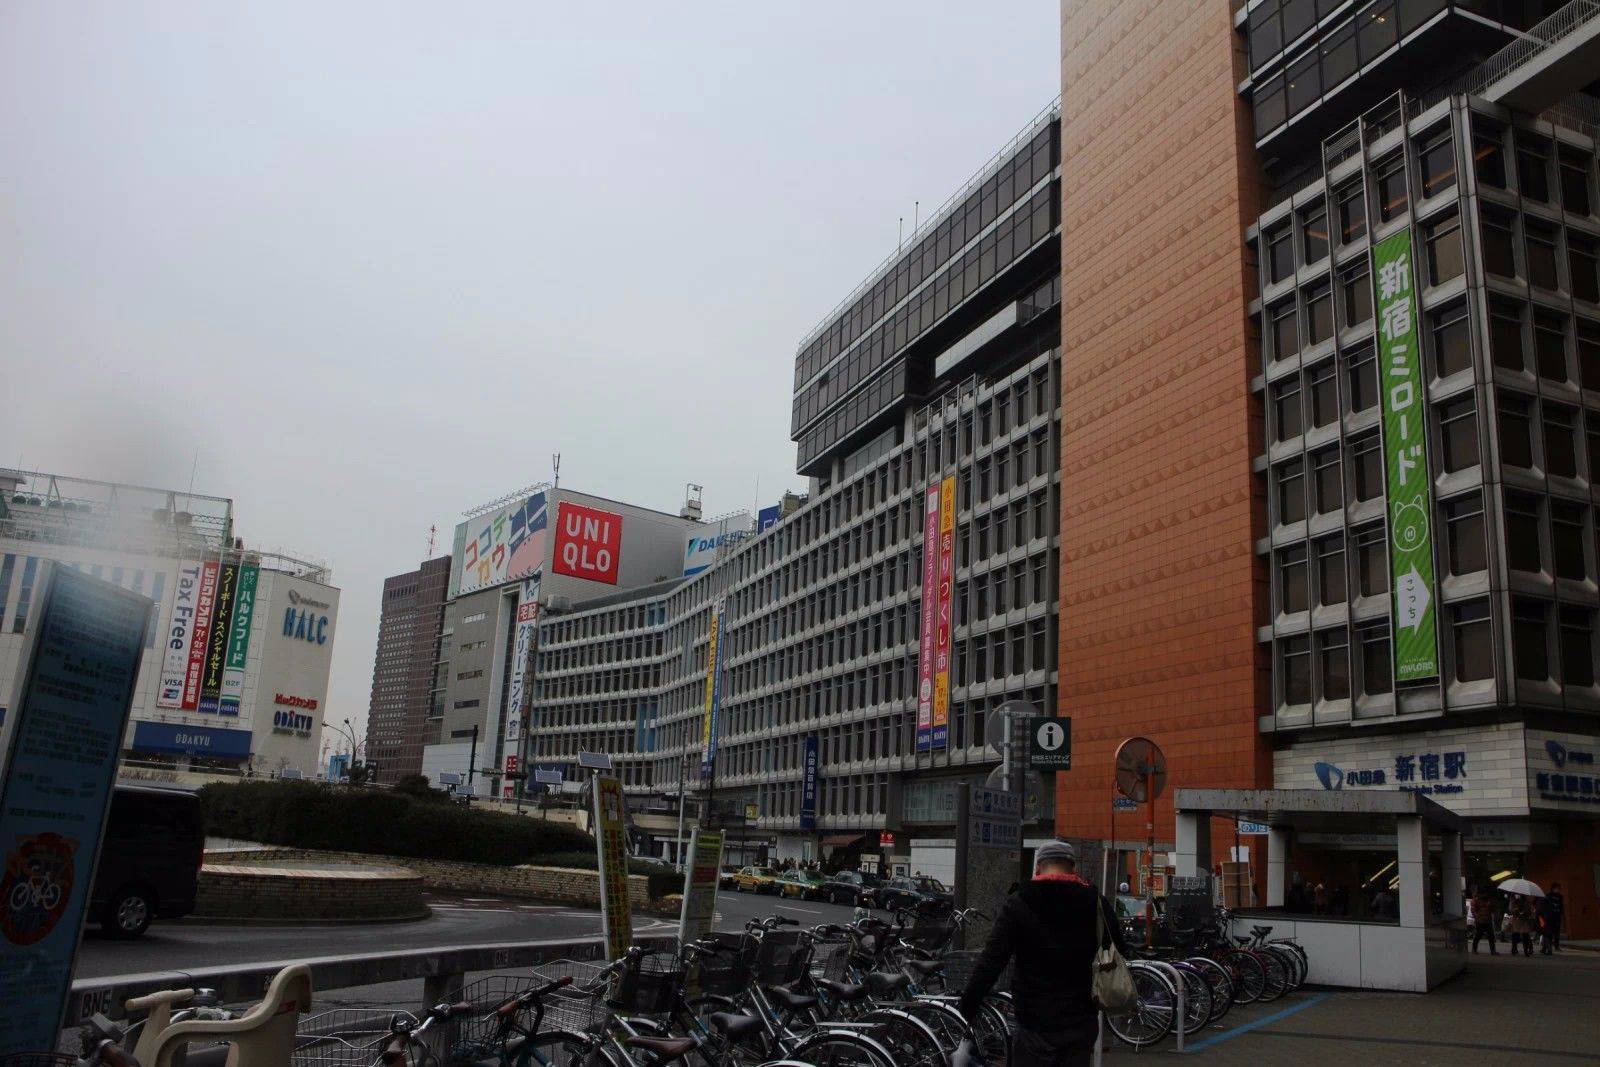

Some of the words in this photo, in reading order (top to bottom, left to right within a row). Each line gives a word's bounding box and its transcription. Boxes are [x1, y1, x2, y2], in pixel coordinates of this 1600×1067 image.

[1379, 253, 1421, 486] 新宿ミロード
[565, 512, 610, 544] UNI
[563, 542, 612, 573] QLO
[178, 566, 200, 602] Tax
[170, 606, 194, 650] Free
[232, 590, 252, 664] ハルクフード
[283, 607, 329, 646] HALC
[164, 679, 183, 687] VISA
[273, 710, 313, 731] ODAKYU
[175, 733, 211, 746] ODAKYU
[1346, 769, 1386, 786] 小田急
[1394, 751, 1467, 782] 新宿駅
[1433, 784, 1464, 794] Station
